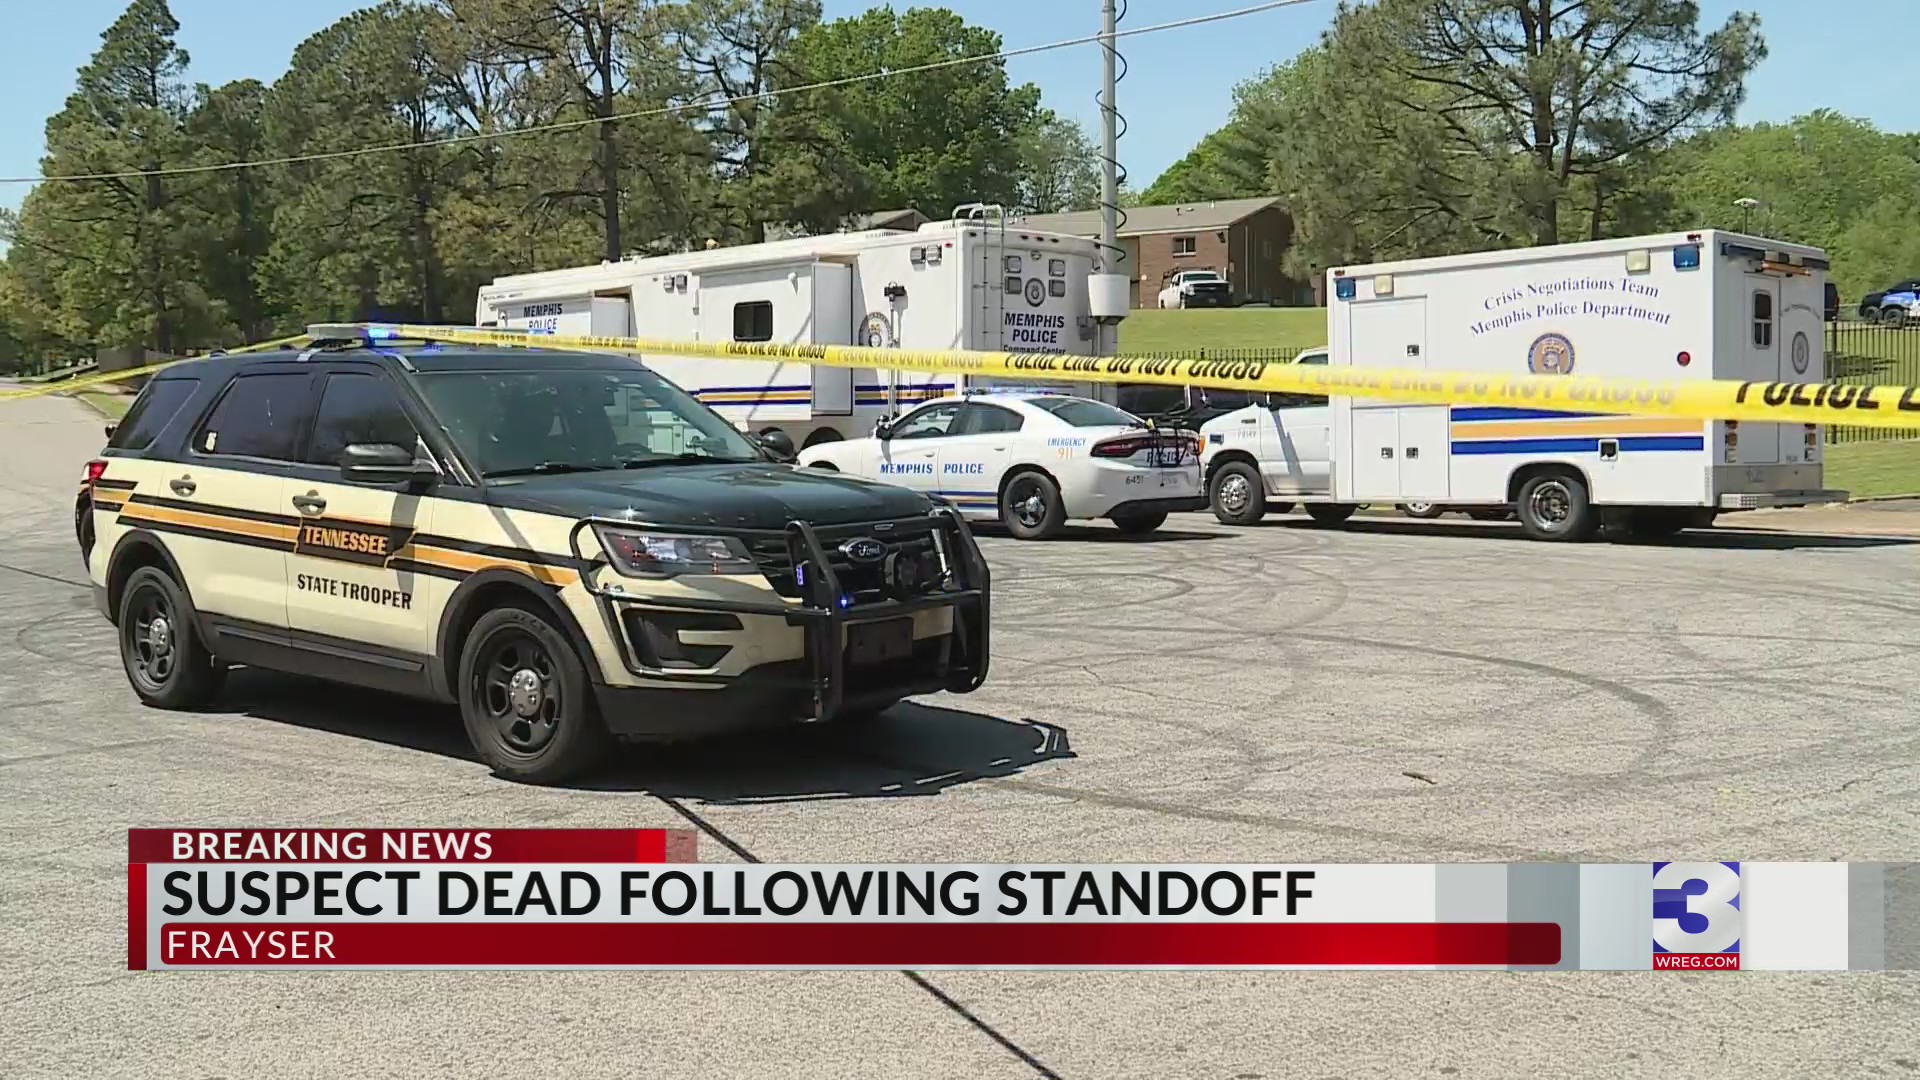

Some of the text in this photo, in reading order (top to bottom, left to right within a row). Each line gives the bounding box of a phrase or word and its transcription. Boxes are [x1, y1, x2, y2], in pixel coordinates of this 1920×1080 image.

[1484, 276, 1659, 311] Crisis Negotiations Team
[523, 303, 563, 318] MEMPHIS
[528, 318, 558, 330] POLICE
[1004, 312, 1066, 329] MEMPHIS
[1470, 300, 1671, 337] Memphis Police Department
[1012, 328, 1059, 344] POLICE
[1003, 343, 1067, 355] Command Center
[1047, 437, 1087, 447] EMERGENCY
[1056, 447, 1074, 460] 911
[880, 463, 985, 475] MEMPHIS POLICE
[303, 525, 389, 556] TENNESSEE
[857, 543, 881, 557] Ford
[297, 573, 413, 610] STATE TROOPER
